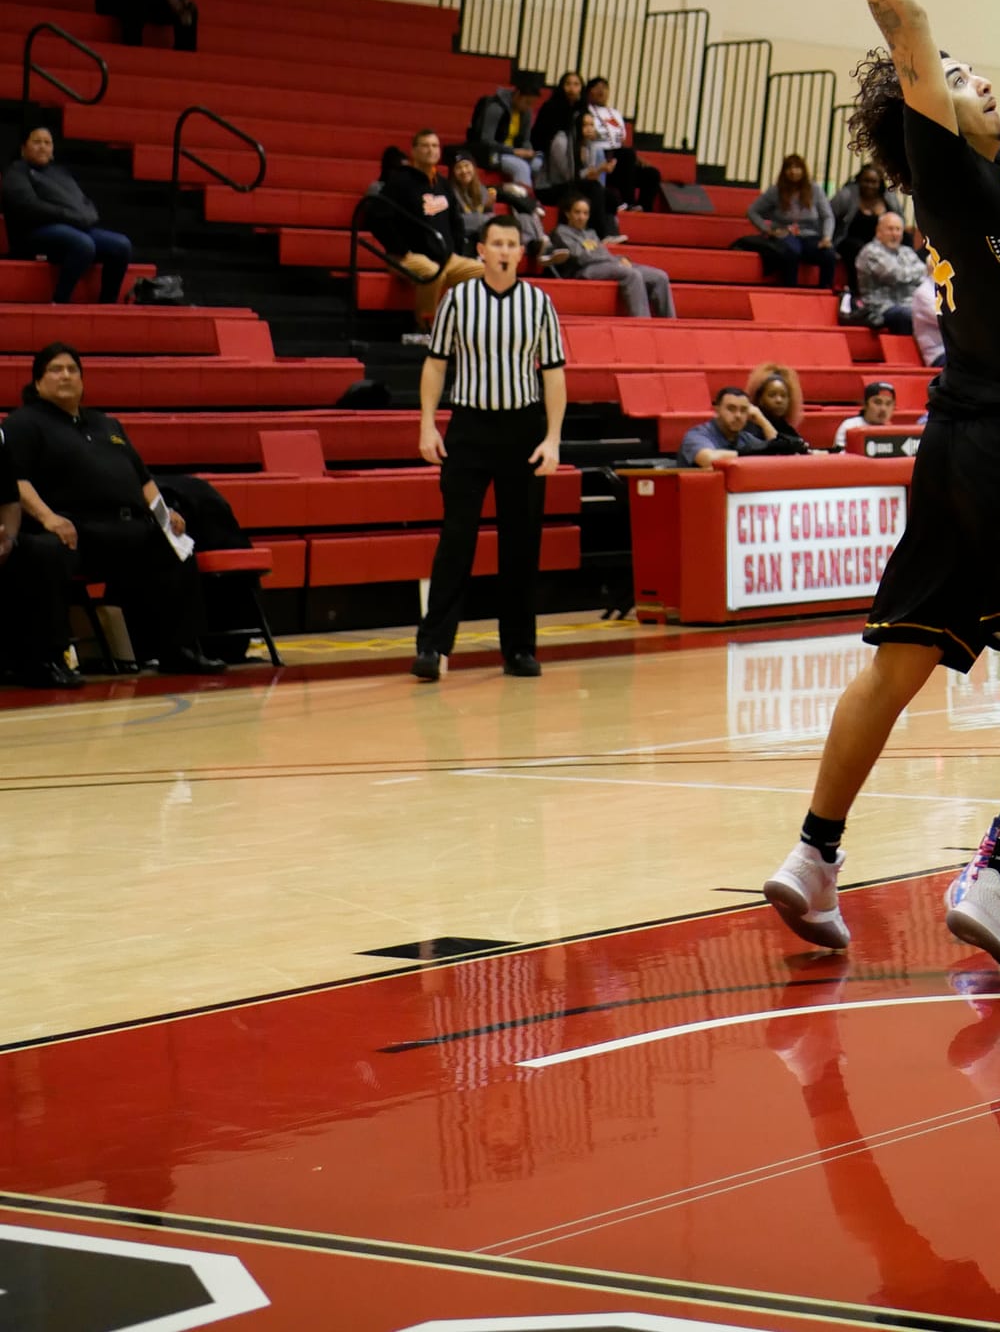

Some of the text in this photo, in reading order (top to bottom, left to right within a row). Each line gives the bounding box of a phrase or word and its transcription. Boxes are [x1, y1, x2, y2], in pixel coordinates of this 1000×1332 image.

[737, 497, 899, 544] CITY COLLEGE OF
[743, 552, 782, 595] SAN
